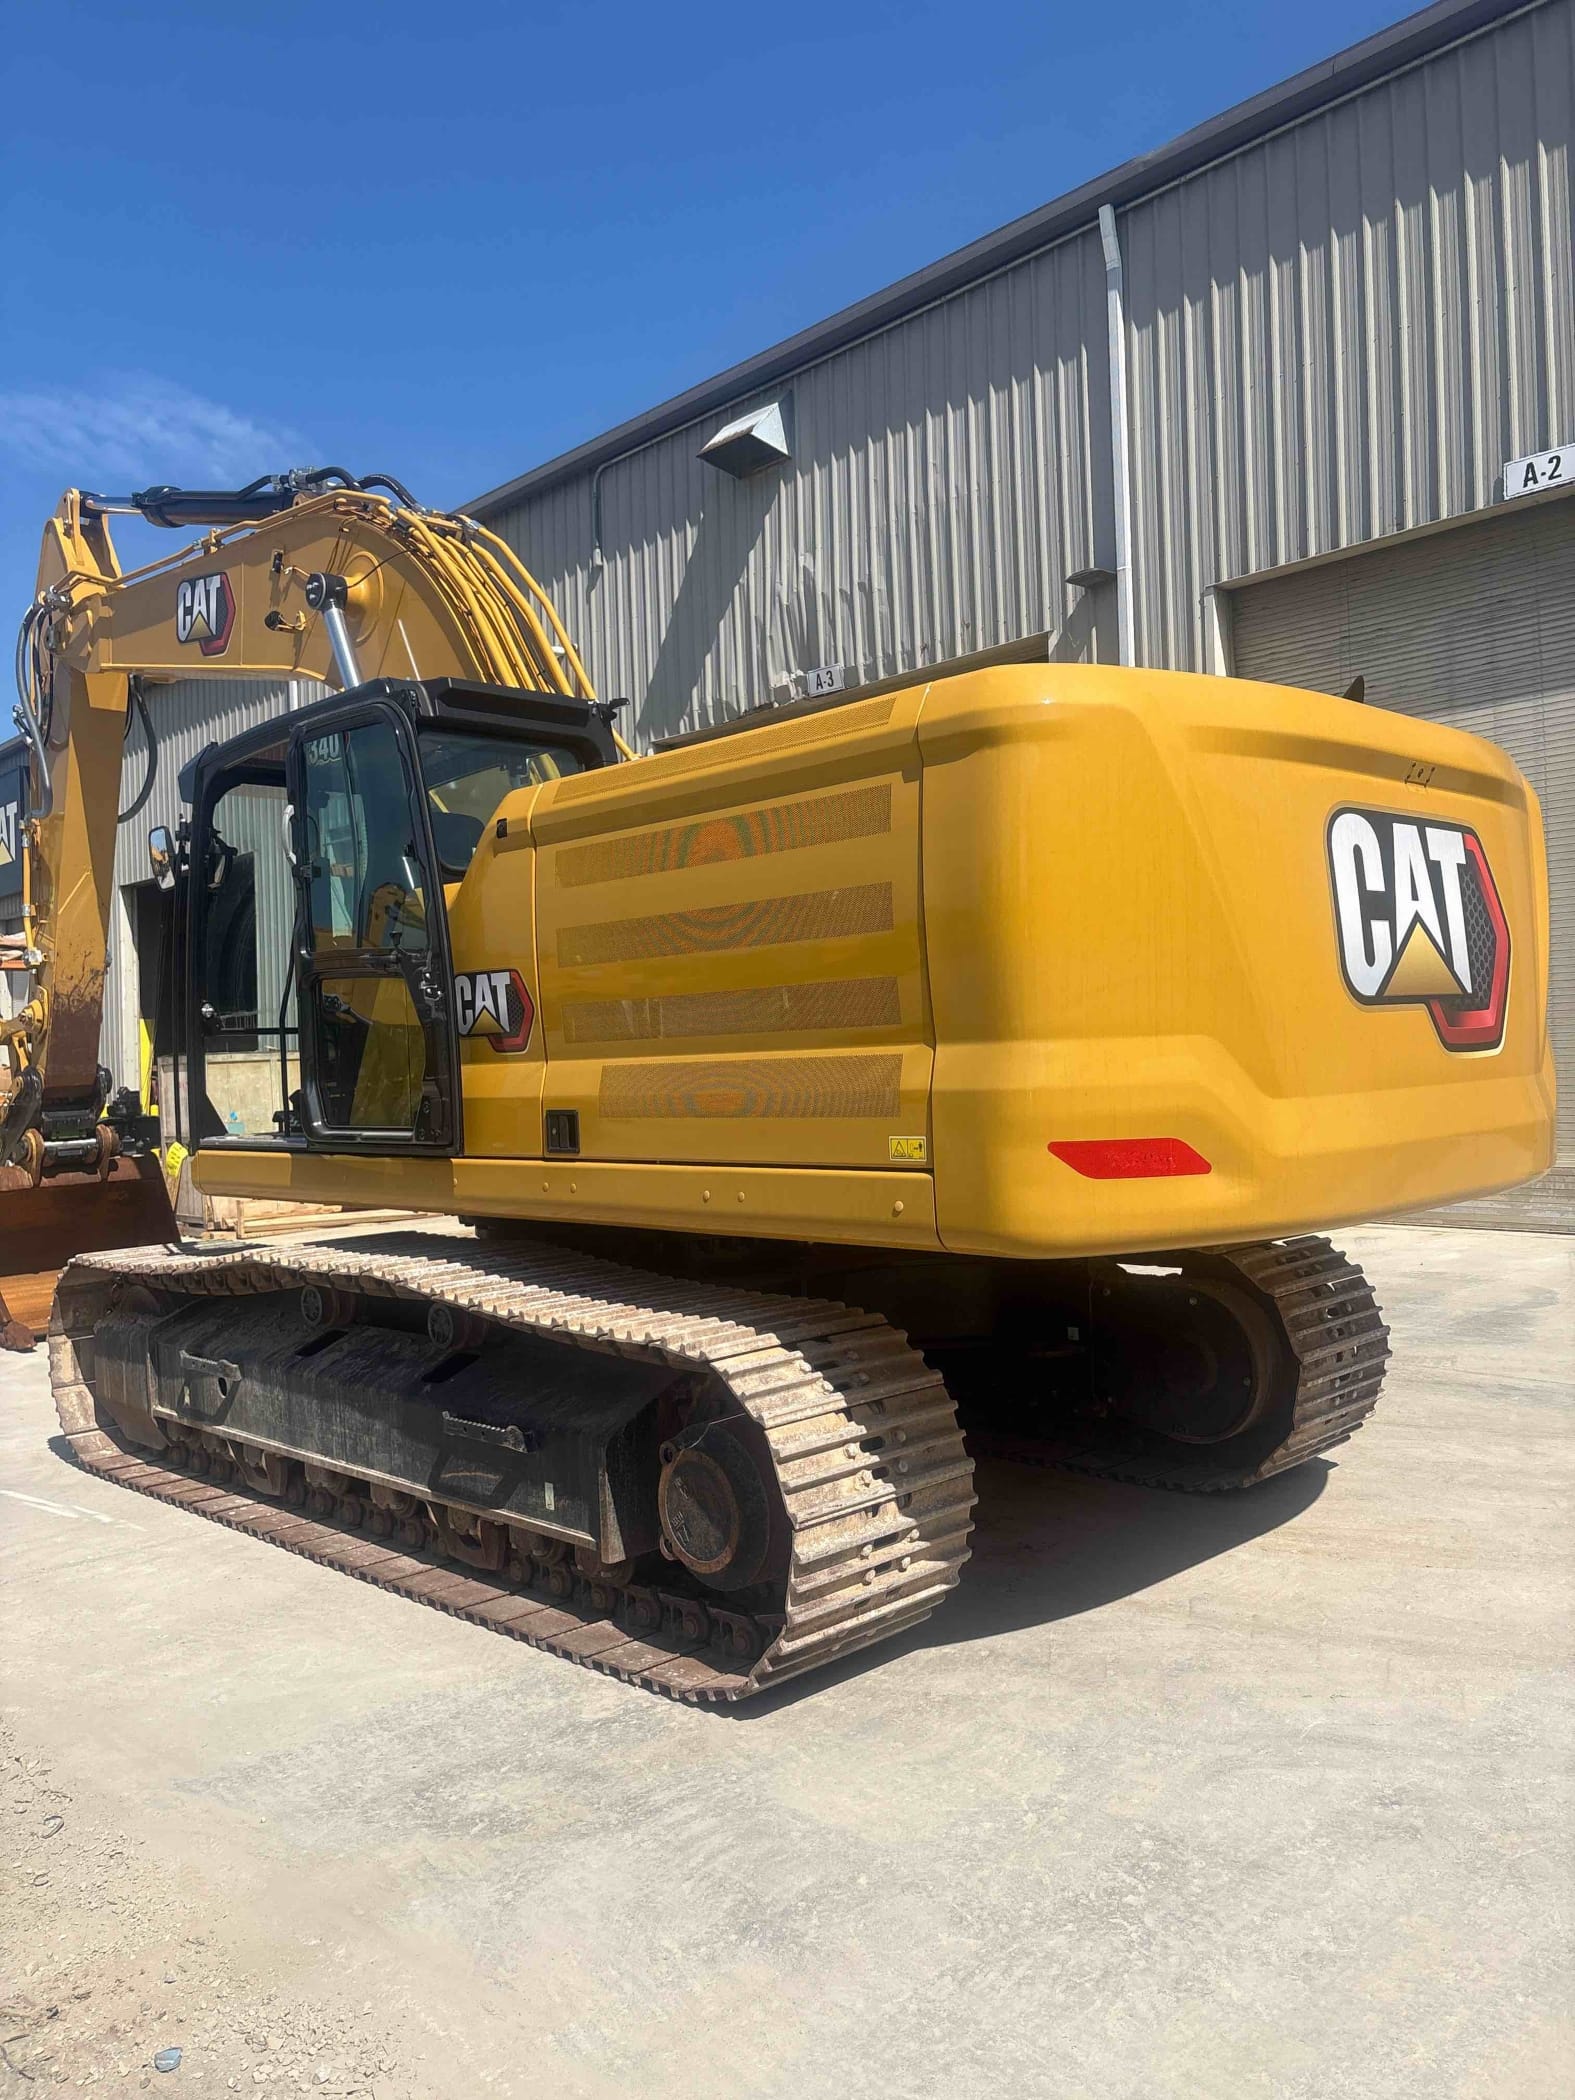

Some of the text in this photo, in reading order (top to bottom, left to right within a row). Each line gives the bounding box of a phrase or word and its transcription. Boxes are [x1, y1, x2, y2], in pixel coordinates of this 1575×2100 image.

[1523, 455, 1562, 488] A-2
[178, 575, 220, 641] CAT
[816, 670, 834, 690] A-3
[0, 801, 17, 861] AT
[1331, 813, 1472, 996] CAT
[455, 972, 510, 1035] CAT
